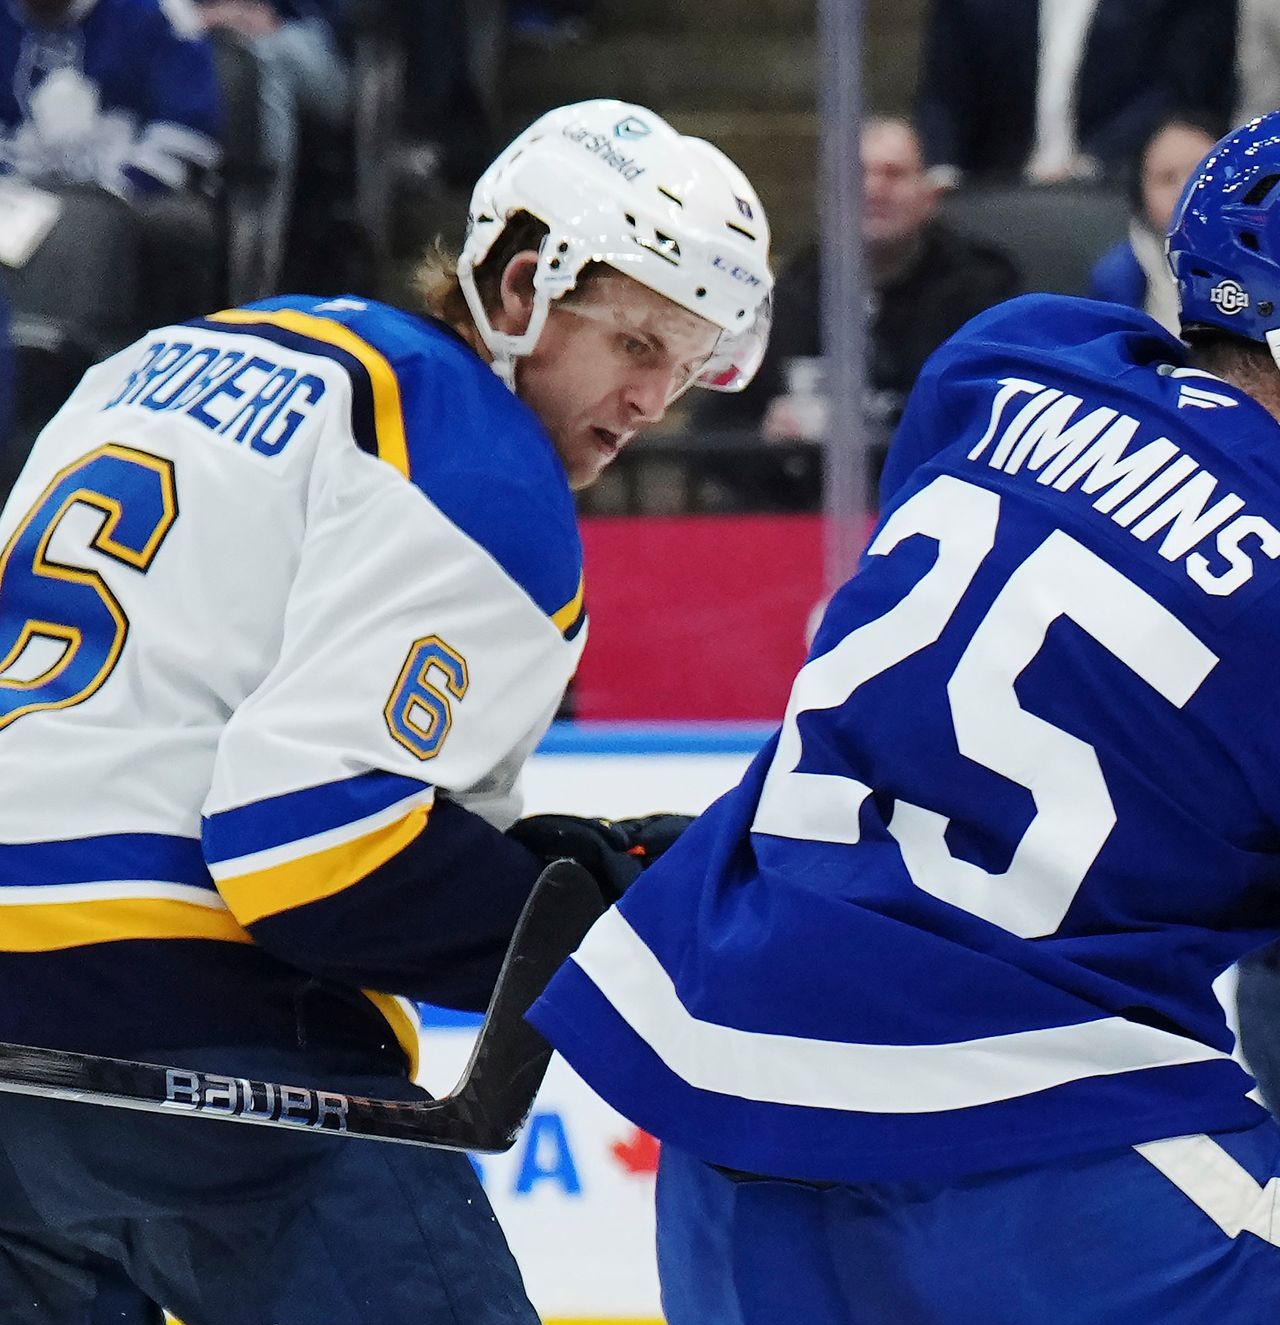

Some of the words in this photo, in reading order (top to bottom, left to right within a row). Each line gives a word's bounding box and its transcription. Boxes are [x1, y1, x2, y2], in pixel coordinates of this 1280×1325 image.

[101, 341, 327, 458] BROBERG
[0, 442, 180, 733] 6
[383, 634, 470, 762] 6
[750, 474, 1221, 940] 25
